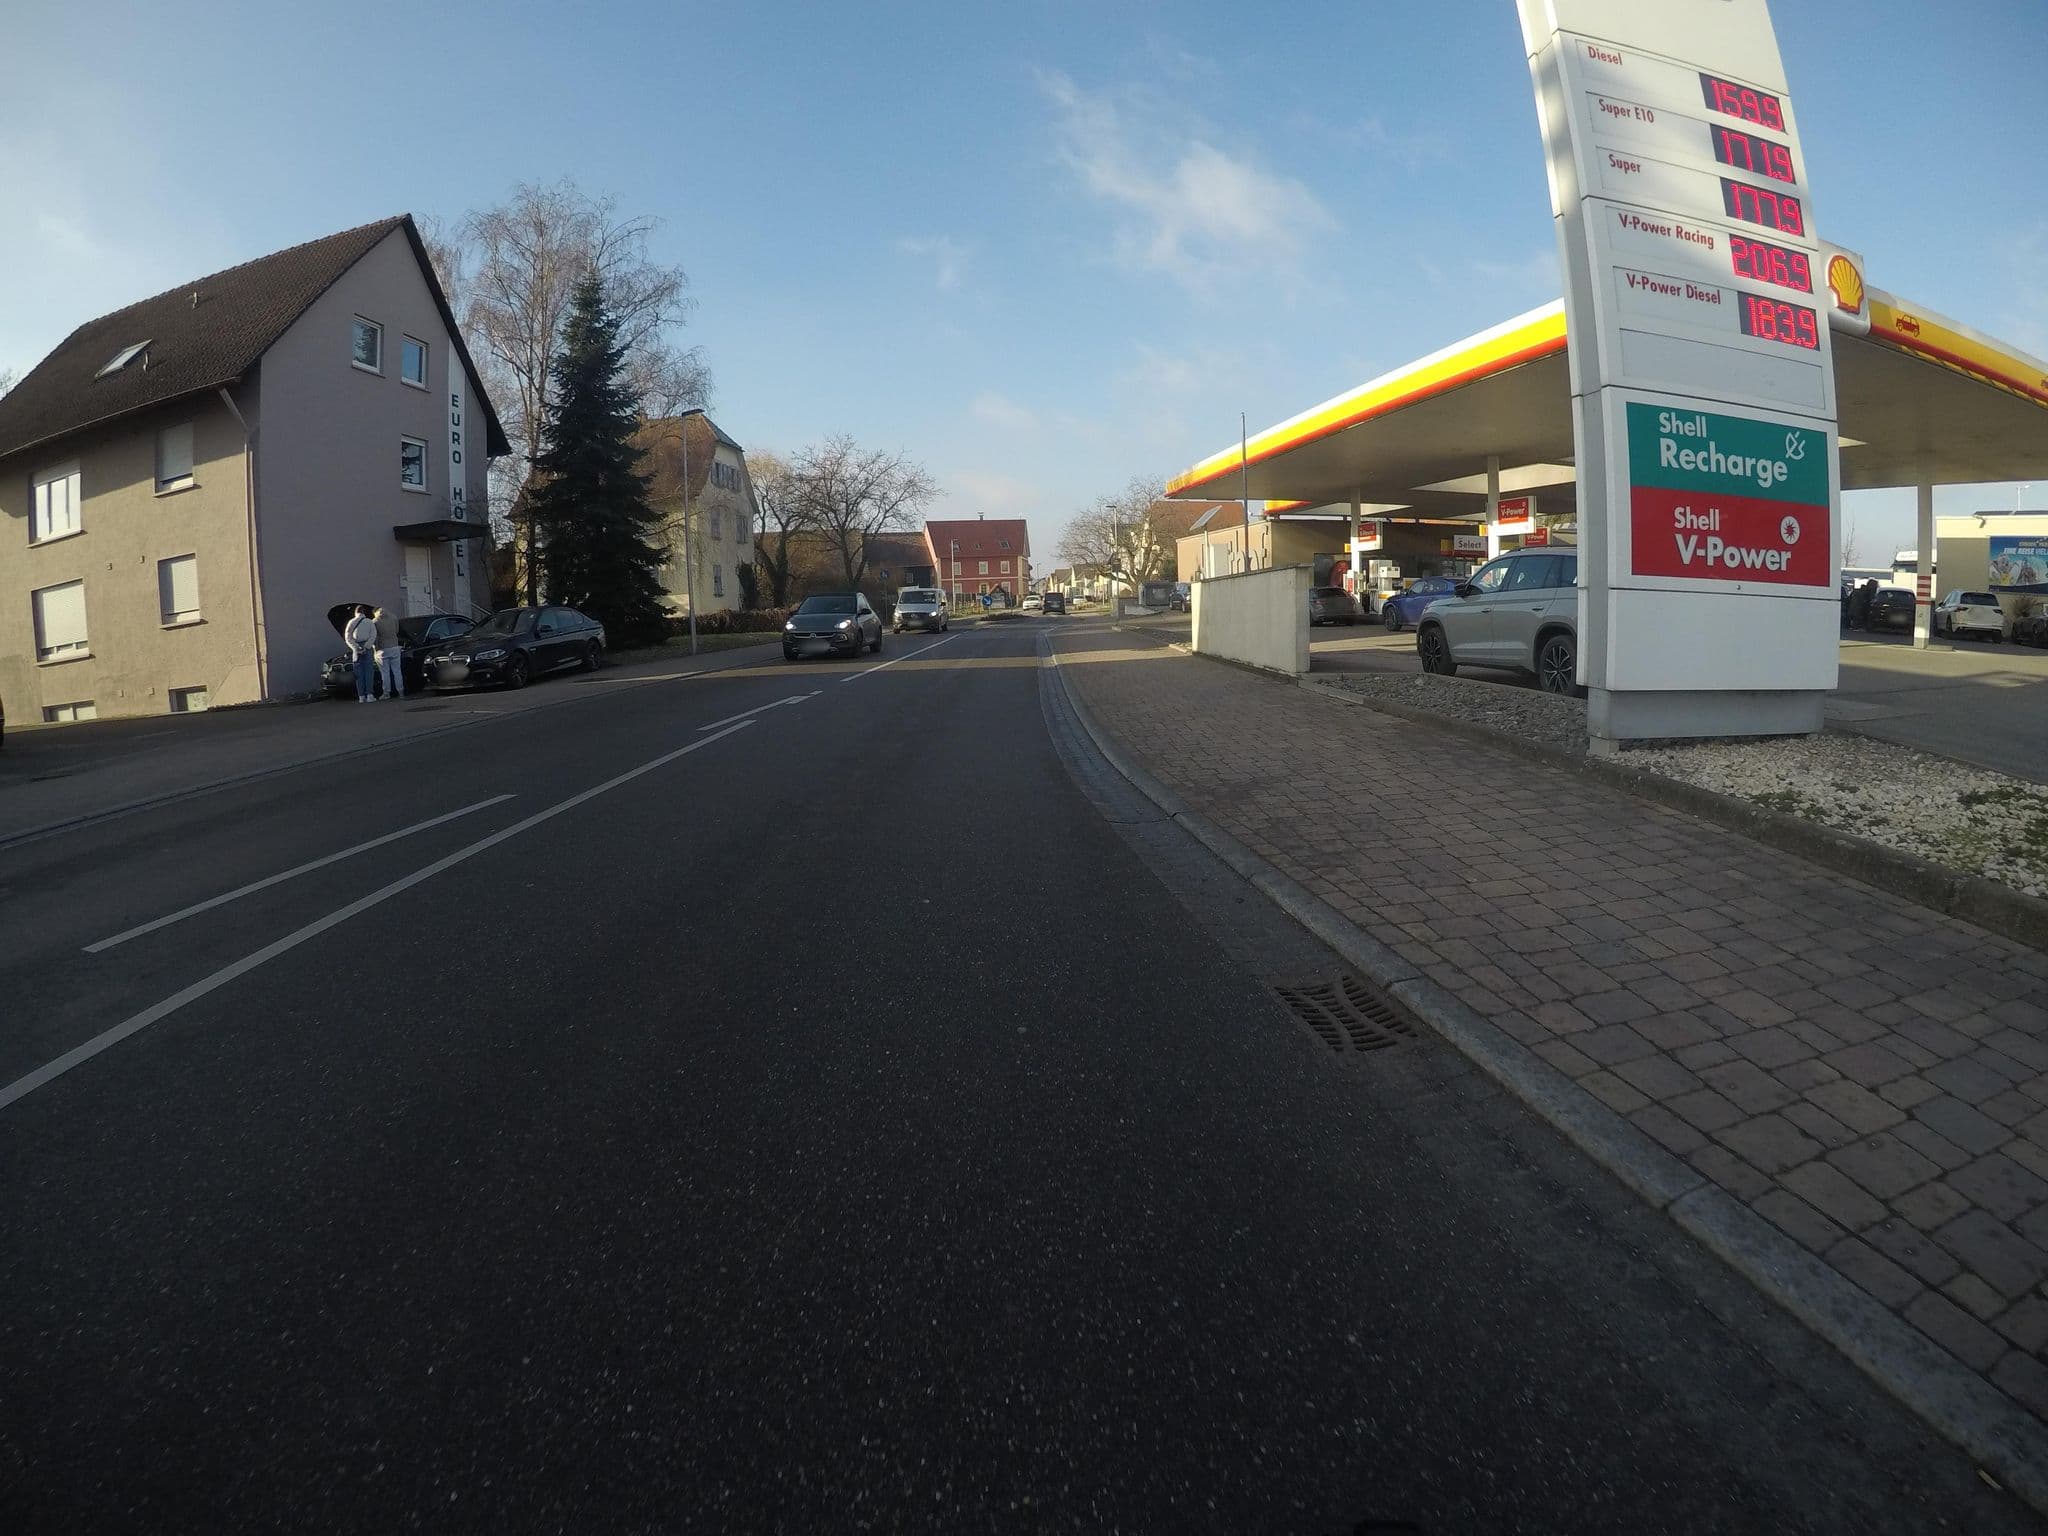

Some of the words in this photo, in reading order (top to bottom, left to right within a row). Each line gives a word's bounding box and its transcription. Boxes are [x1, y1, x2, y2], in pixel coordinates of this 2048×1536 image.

[1588, 46, 1623, 65] Diesel
[1599, 99, 1631, 118] Super
[1634, 107, 1655, 124] E10
[1608, 154, 1641, 174] Super
[1618, 213, 1672, 237] V-Power
[1676, 225, 1714, 250] Racing
[1626, 273, 1682, 297] V-Power
[1686, 284, 1721, 305] Diesel
[451, 394, 462, 465] EURO
[1658, 412, 1707, 438] Shell
[1660, 437, 1788, 488] Recharge
[453, 487, 465, 577] HOEL
[1674, 506, 1720, 531] Shell
[1458, 540, 1482, 549] Select
[1674, 533, 1792, 571] V-Power
